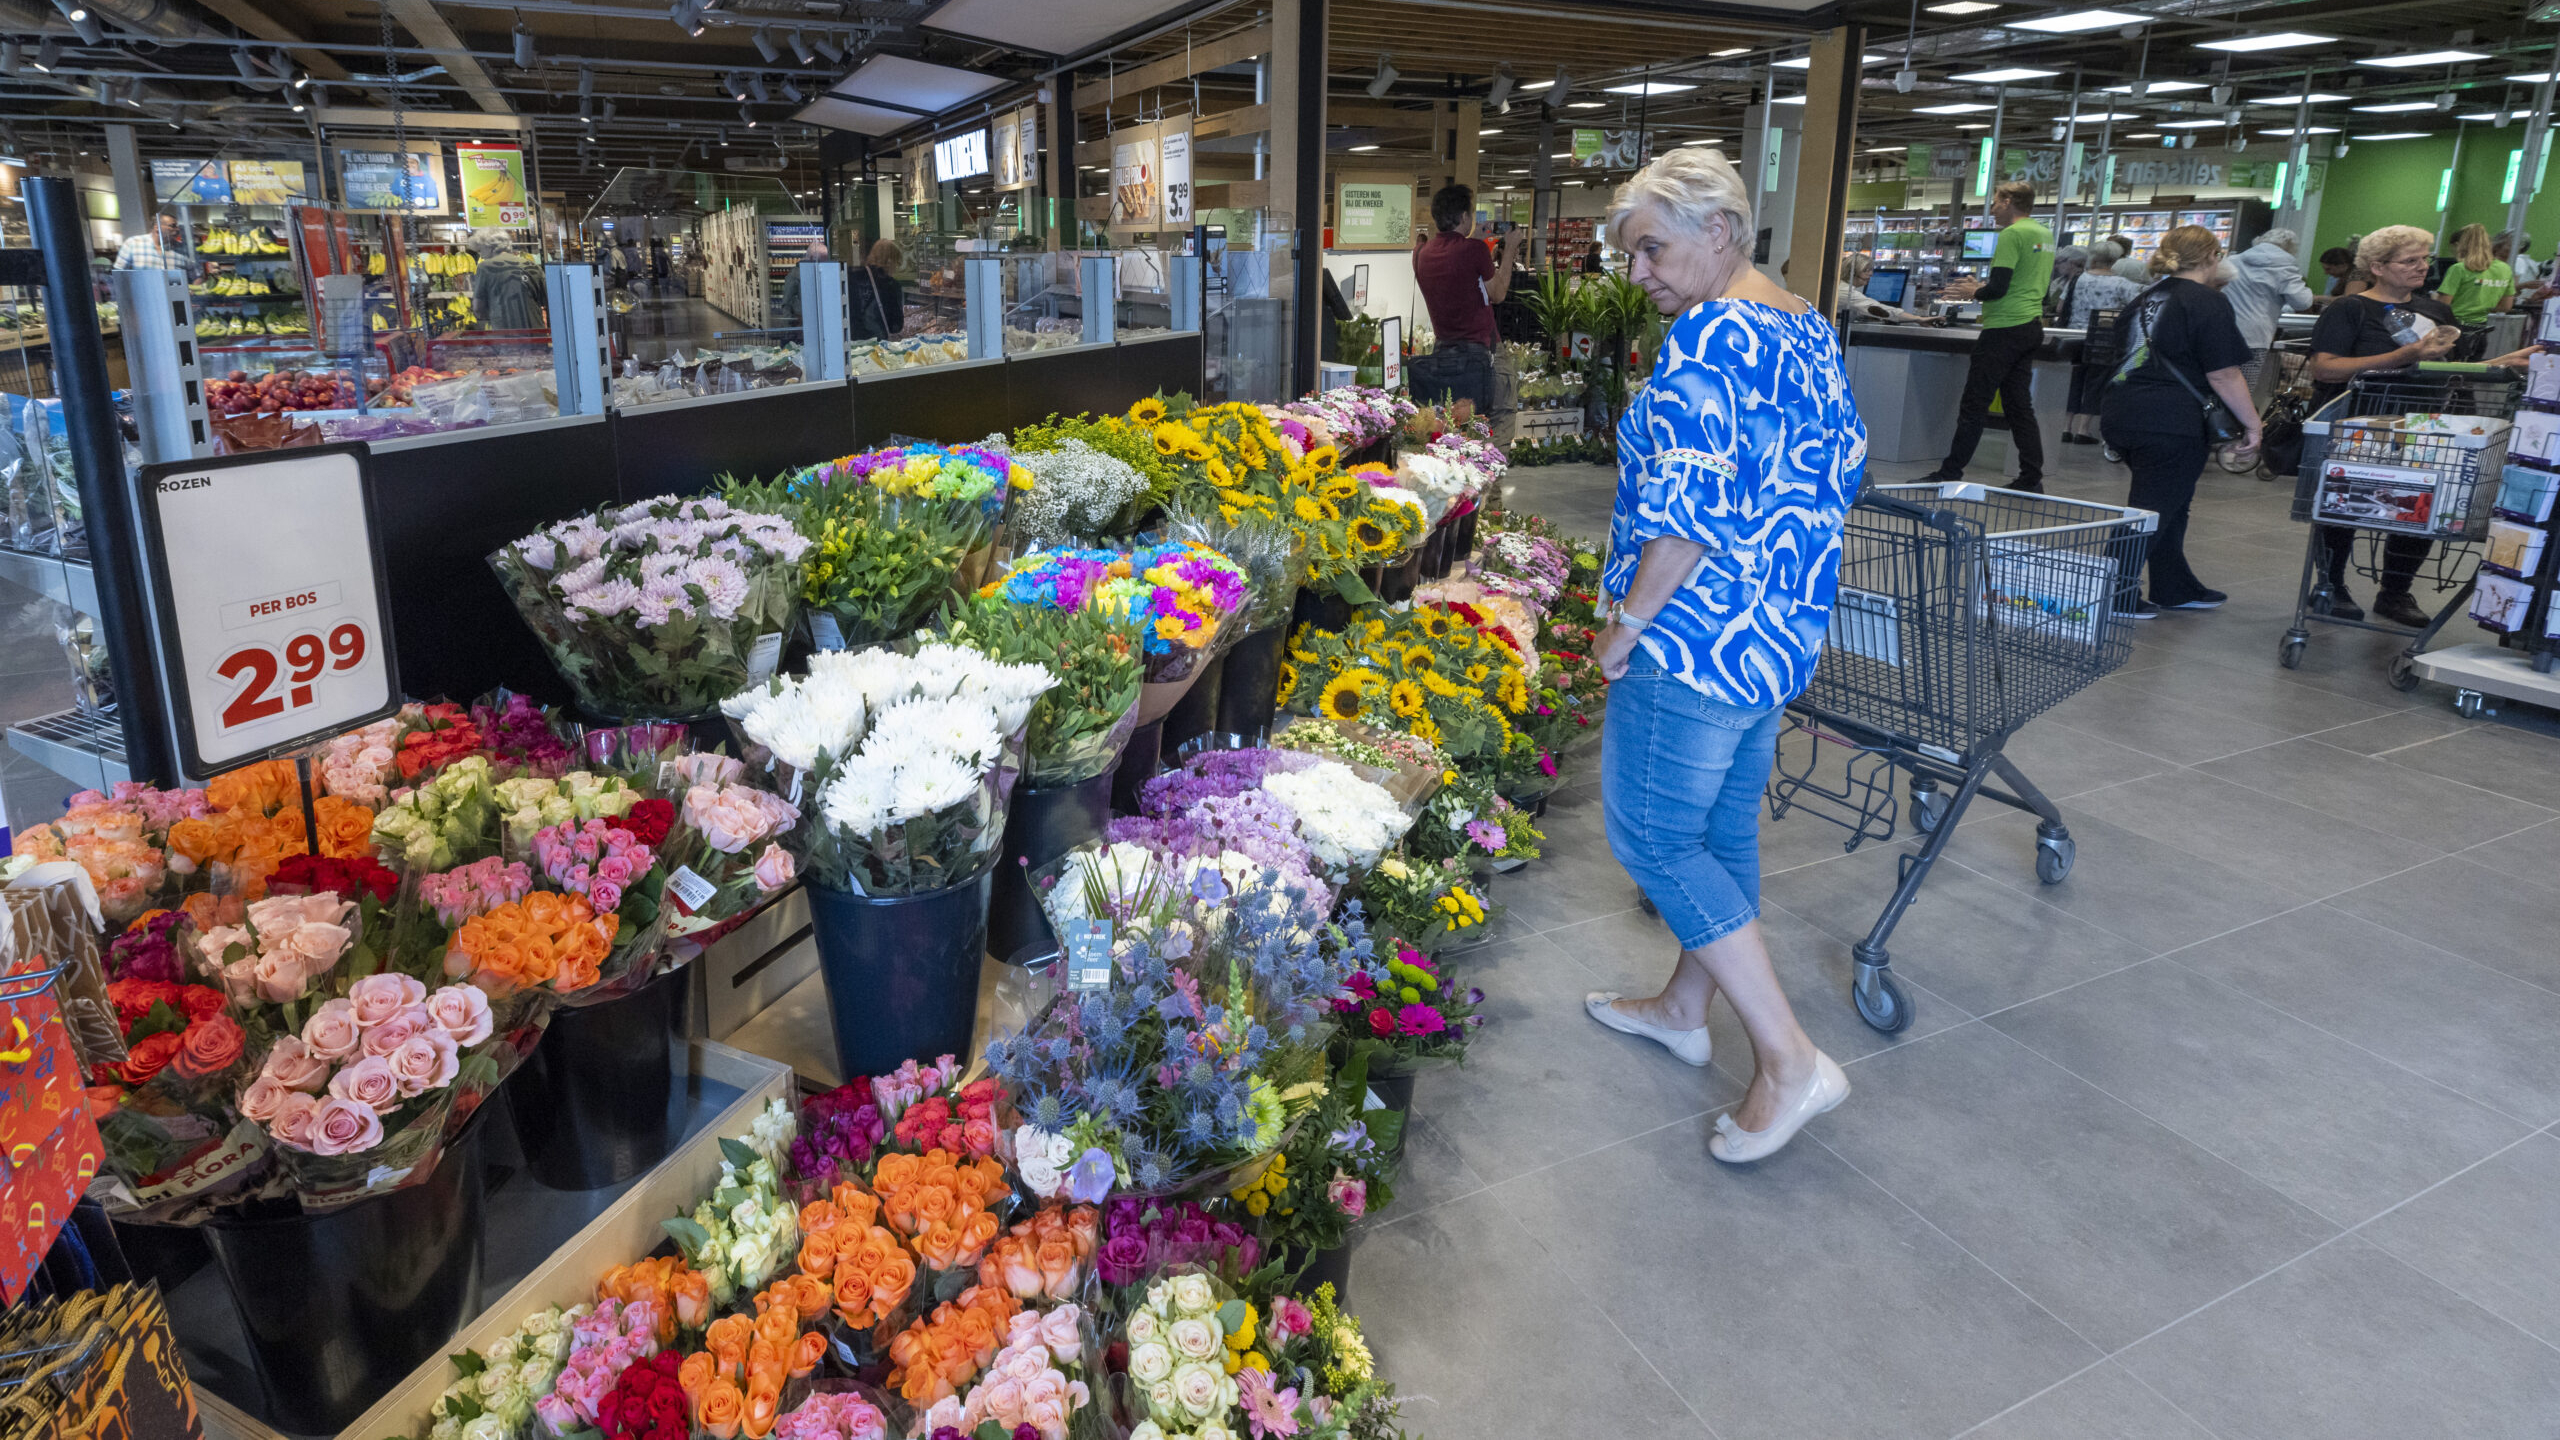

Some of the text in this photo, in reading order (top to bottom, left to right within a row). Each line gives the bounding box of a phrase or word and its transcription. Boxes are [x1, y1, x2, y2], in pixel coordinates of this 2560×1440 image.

[1168, 182, 1188, 217] 3.99
[1345, 190, 1382, 198] GISTEREN NOG
[500, 212, 526, 224] 0.99
[2482, 279, 2509, 287] PLUS
[157, 476, 212, 493] ROZEN
[249, 591, 317, 618] PER BOS
[216, 623, 366, 729] 2.99
[181, 1142, 255, 1188] FLORA
